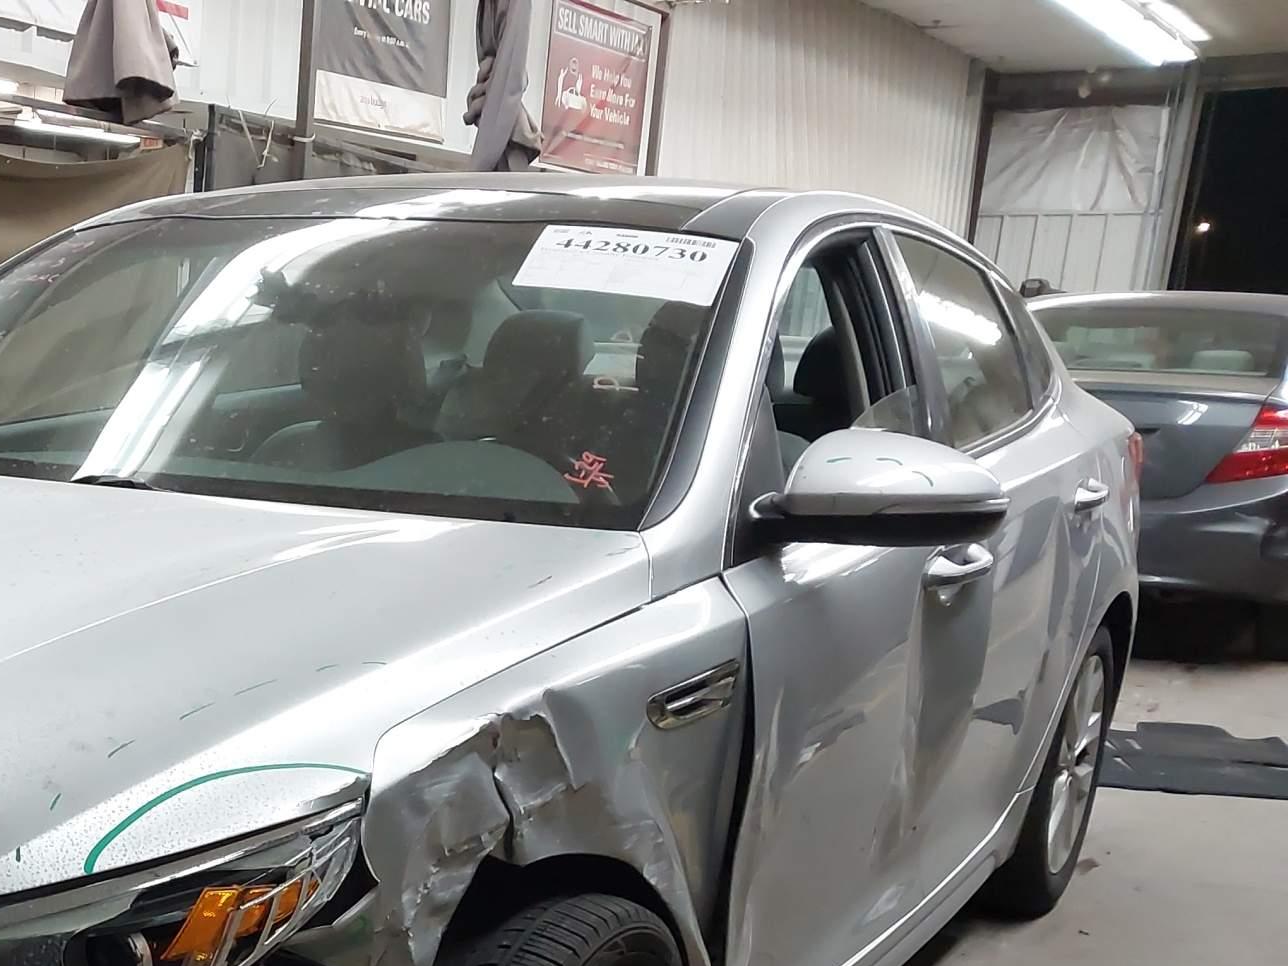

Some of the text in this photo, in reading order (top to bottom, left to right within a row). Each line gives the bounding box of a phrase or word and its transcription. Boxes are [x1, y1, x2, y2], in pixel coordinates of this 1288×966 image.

[395, 0, 430, 24] CARS
[557, 7, 578, 34] SELL
[578, 14, 609, 44] SMART
[609, 25, 631, 52] WITH
[591, 65, 632, 89] We Help You
[606, 88, 624, 106] More
[624, 93, 636, 108] For
[589, 103, 630, 125] Your Vehicle
[555, 236, 708, 263] 44280730
